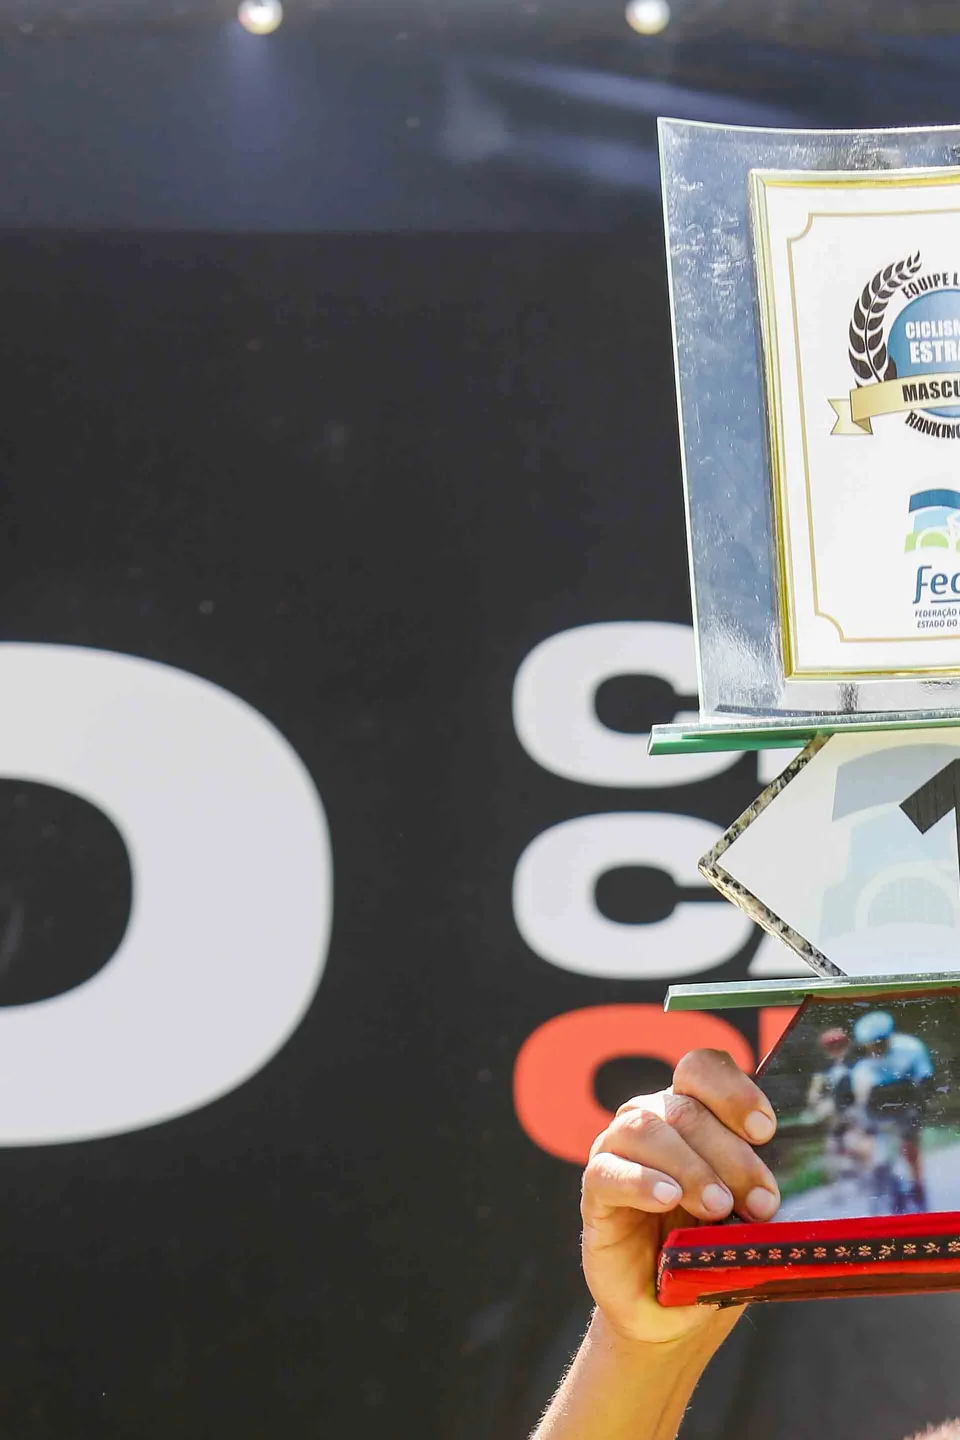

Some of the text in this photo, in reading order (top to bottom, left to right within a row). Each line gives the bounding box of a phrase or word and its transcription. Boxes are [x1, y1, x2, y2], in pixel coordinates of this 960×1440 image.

[901, 272, 949, 300] EQUIPE
[917, 619, 945, 629] ESTADO
[947, 619, 958, 627] DO
